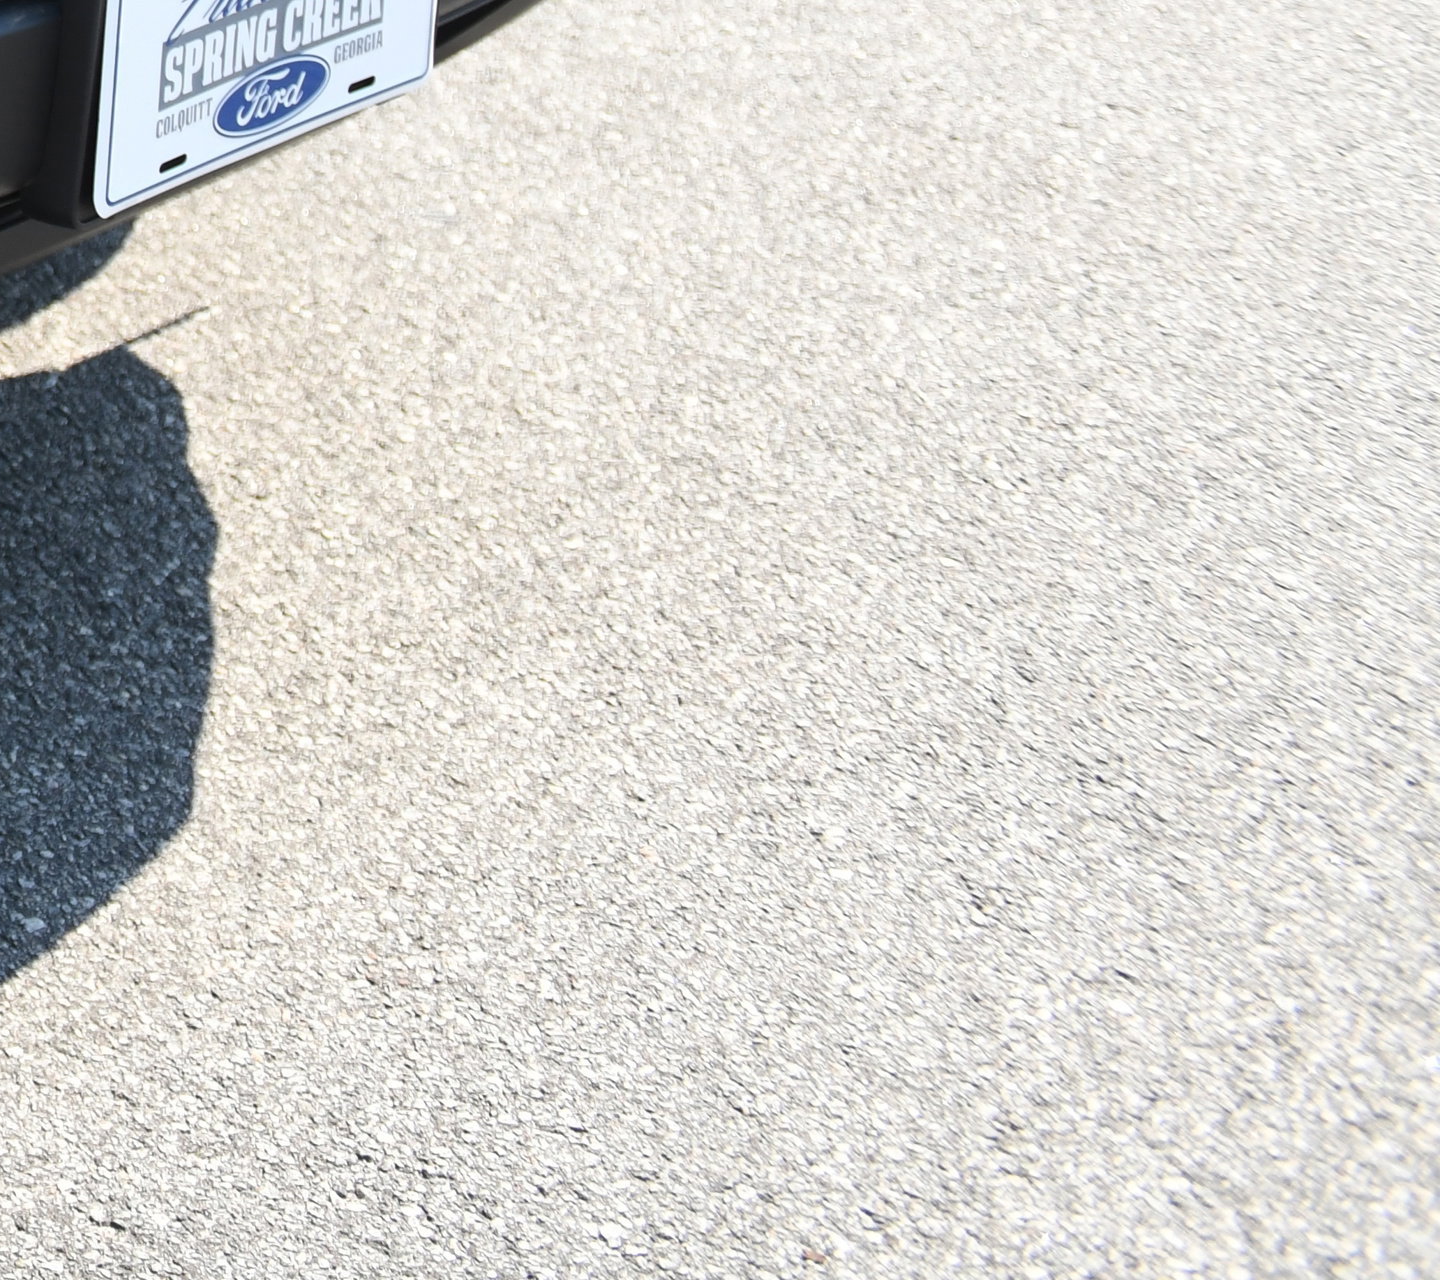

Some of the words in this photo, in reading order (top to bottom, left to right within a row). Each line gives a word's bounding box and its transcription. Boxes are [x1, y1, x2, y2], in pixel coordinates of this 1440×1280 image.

[163, 13, 277, 103] SPRING
[333, 29, 384, 65] GEORGIA
[155, 97, 214, 139] COLQUITT
[235, 67, 304, 127] Ford
